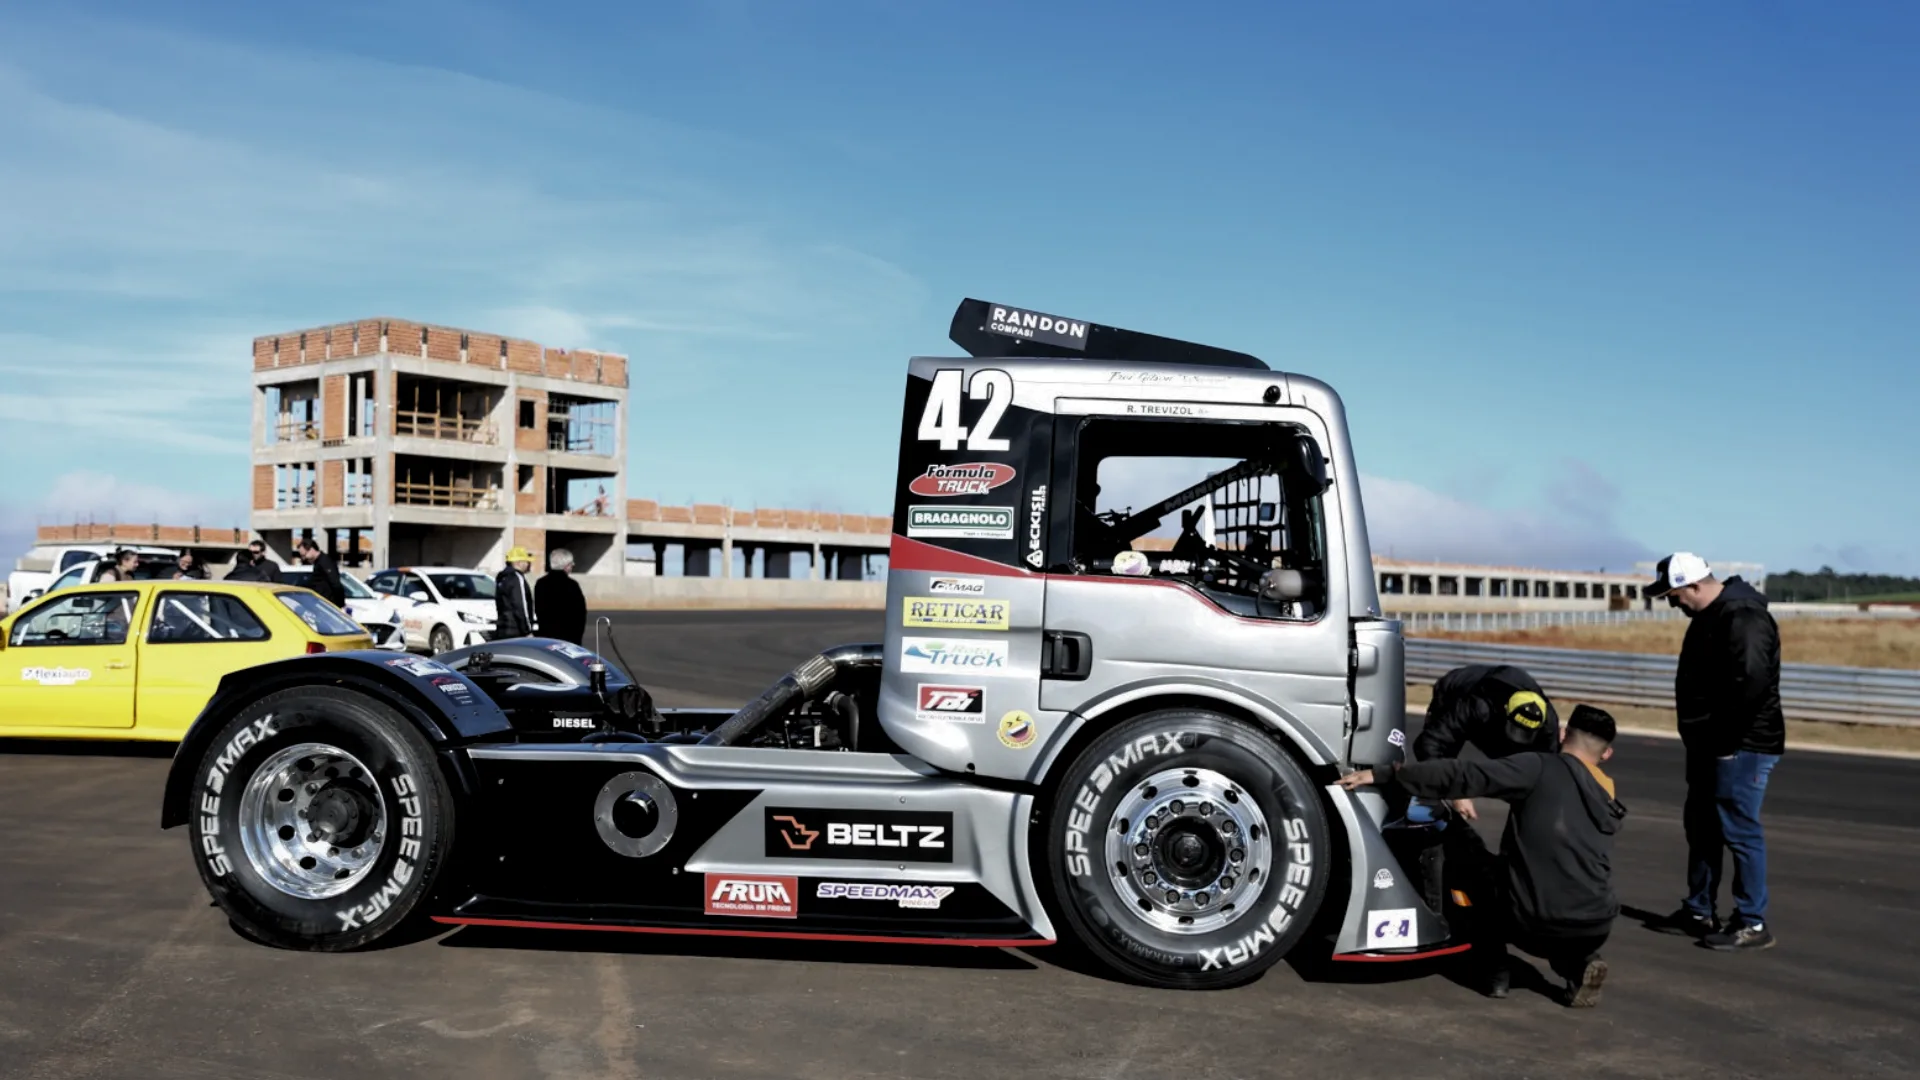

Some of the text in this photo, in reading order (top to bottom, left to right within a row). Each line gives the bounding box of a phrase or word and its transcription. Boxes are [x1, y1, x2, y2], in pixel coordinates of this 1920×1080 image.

[993, 307, 1085, 338] RANDON
[917, 368, 1014, 451] 42
[1127, 405, 1137, 413] R.
[1141, 405, 1193, 415] TREVIZOL
[927, 464, 996, 479] Fórmula
[937, 480, 990, 495] TRUCK
[914, 512, 1007, 525] BRAGAGNOLO
[910, 601, 1004, 620] RETICAR
[929, 649, 1004, 668] Truck
[553, 718, 596, 728] DIESEL
[827, 823, 945, 848] BELTZ
[711, 879, 791, 904] FRUM
[818, 884, 940, 899] SPEEDMAX
